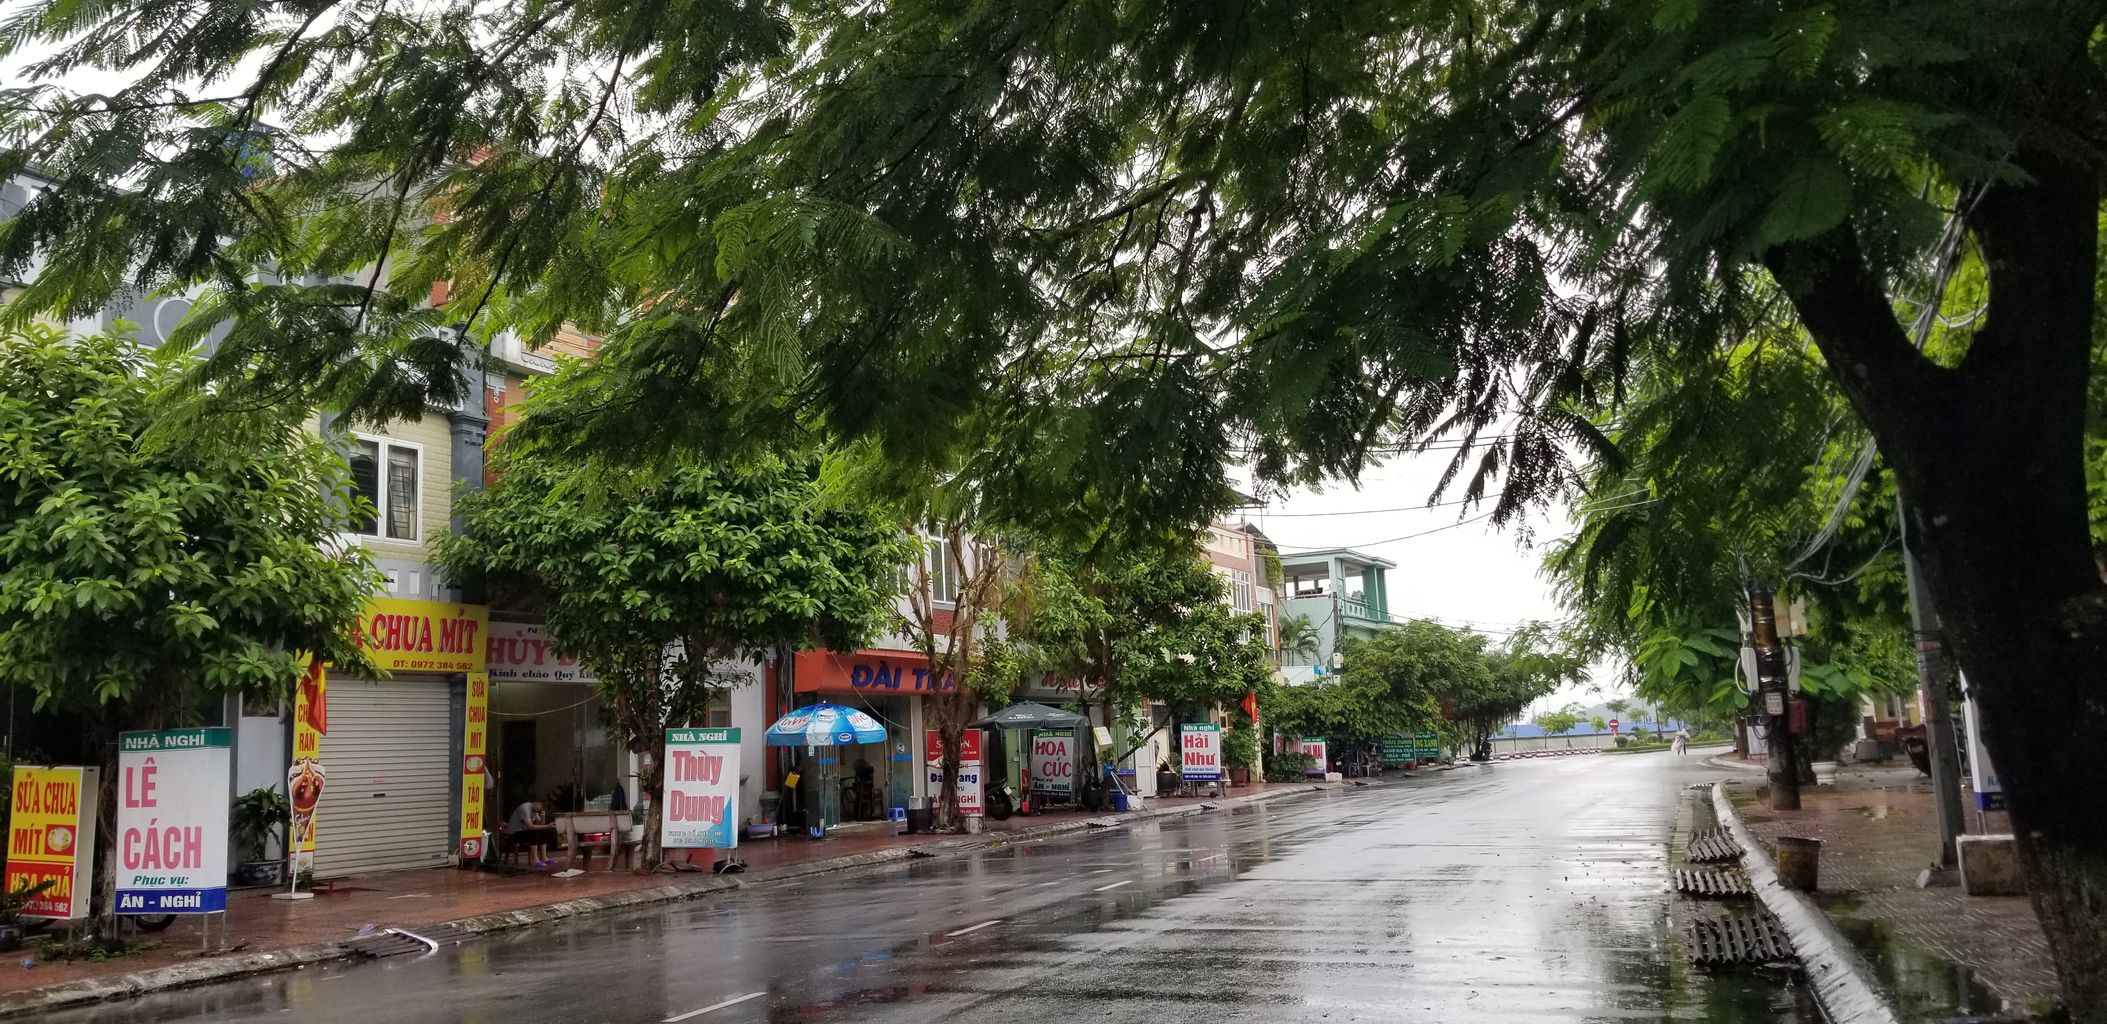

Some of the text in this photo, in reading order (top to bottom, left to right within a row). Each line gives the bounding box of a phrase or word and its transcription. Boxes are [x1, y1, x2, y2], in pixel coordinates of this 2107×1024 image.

[370, 613, 433, 654] CHUA
[439, 608, 478, 655] MÍT
[411, 660, 434, 670] 0972
[851, 660, 902, 689] ĐÀI
[469, 705, 486, 724] CHUA
[125, 730, 205, 750] NHÀ NGHỈ
[299, 728, 315, 751] RÁN
[470, 728, 483, 749] MÍT
[671, 731, 696, 742] NHÀ
[1184, 733, 1209, 748] Hải
[1034, 741, 1067, 756] HOA
[672, 750, 724, 786] Thùy
[1042, 758, 1072, 778] CÚC
[1184, 752, 1216, 766] Như
[125, 757, 158, 809] LÊ
[16, 771, 77, 816] SỮA CHUA
[669, 790, 725, 825] Dung
[13, 823, 43, 856] MÍT
[123, 818, 203, 871] CÁCH
[133, 875, 190, 888] Phục vụ:
[120, 894, 144, 909] ĂN
[160, 891, 201, 909] NGHỈ
